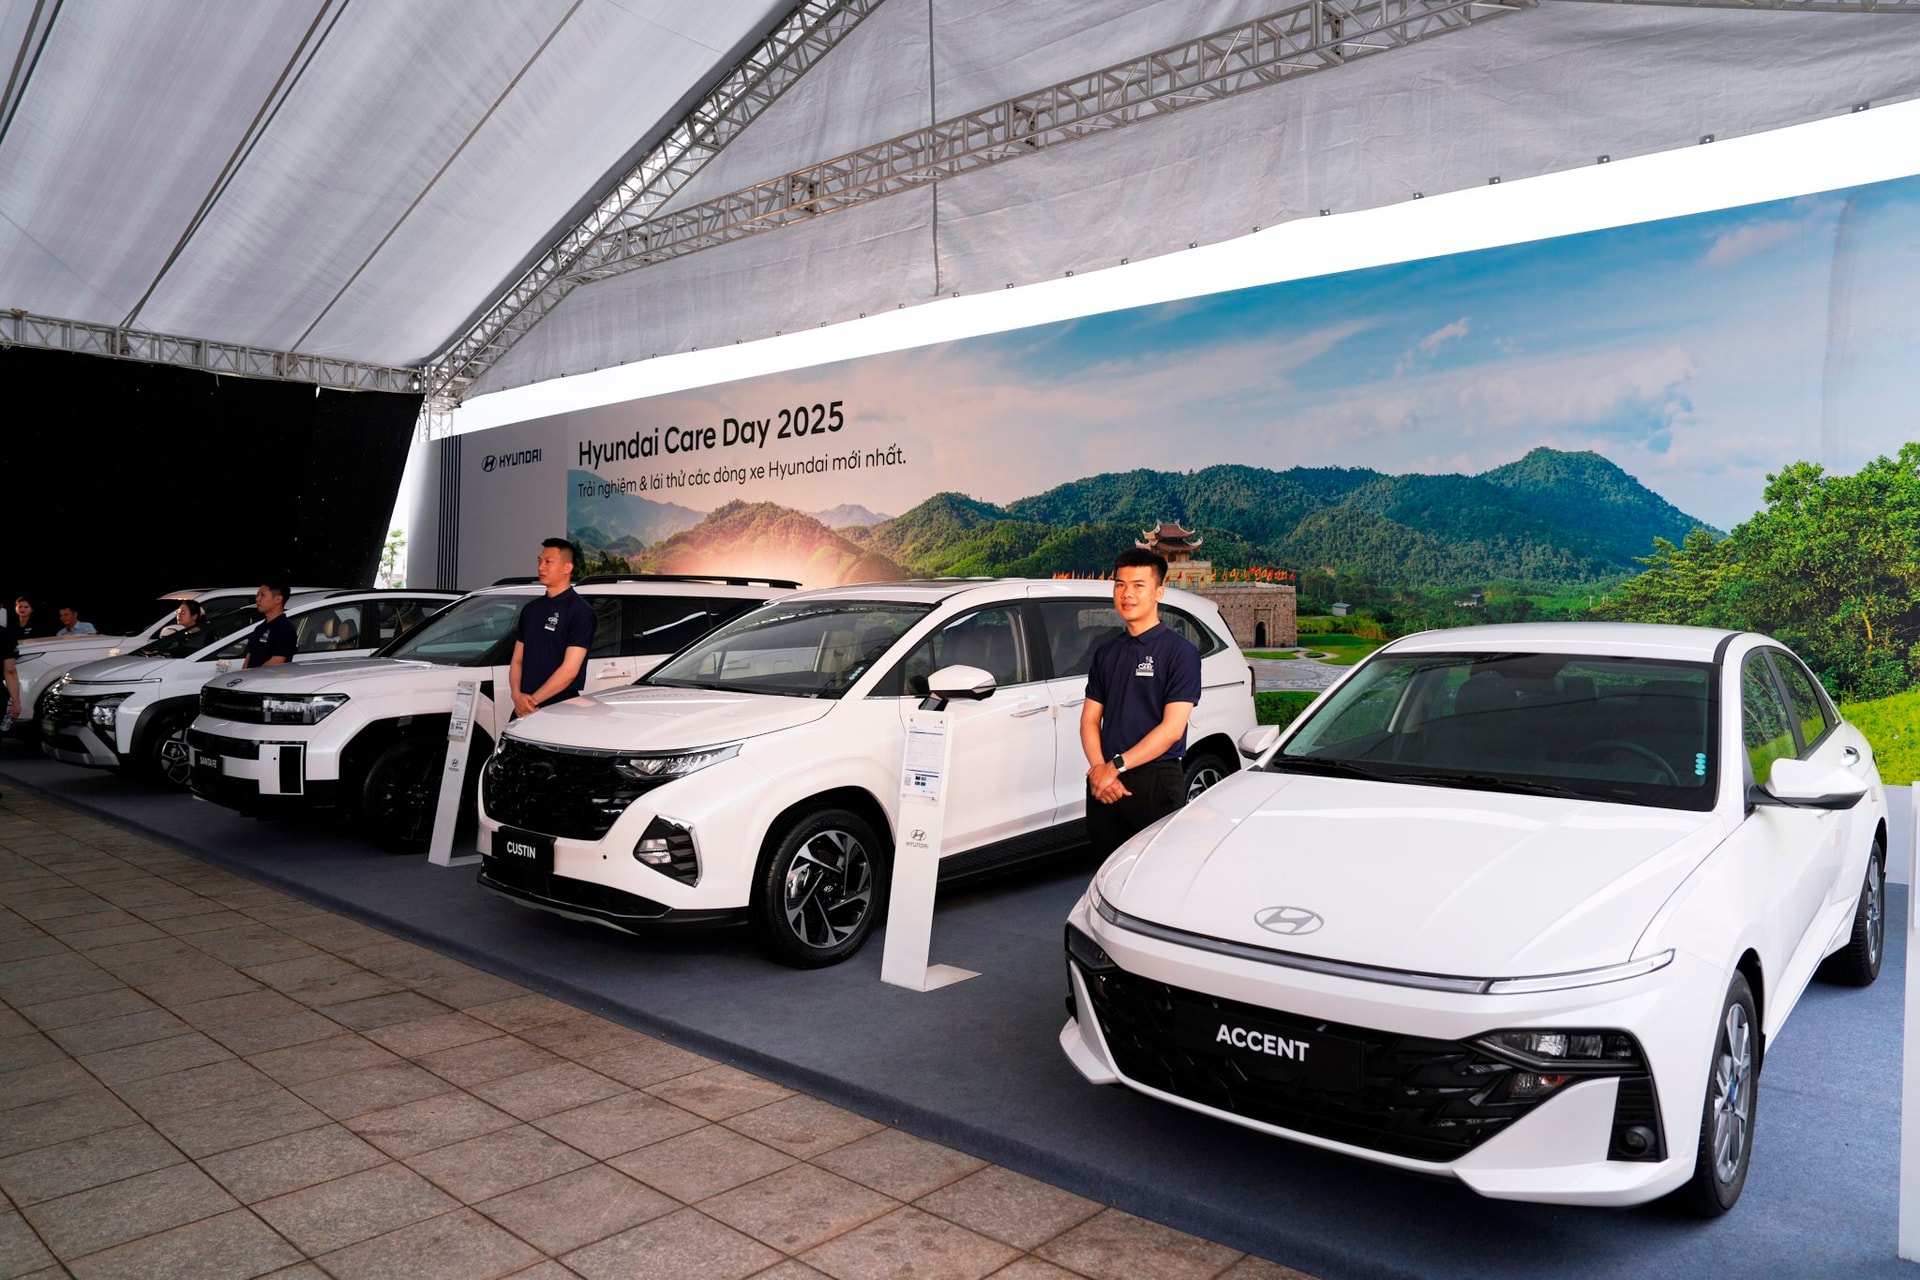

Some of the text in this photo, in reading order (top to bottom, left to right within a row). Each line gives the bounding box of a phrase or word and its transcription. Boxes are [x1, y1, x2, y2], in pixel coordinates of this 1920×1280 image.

[579, 400, 844, 470] Hyundai Care Day 2025
[499, 448, 542, 468] HYUNDAI
[578, 443, 907, 499] Trải nghiệm & lái thử các dòng xe Hyundai mới nhất.
[507, 841, 536, 859] CUSTIN
[1215, 1023, 1310, 1062] ACCENT
